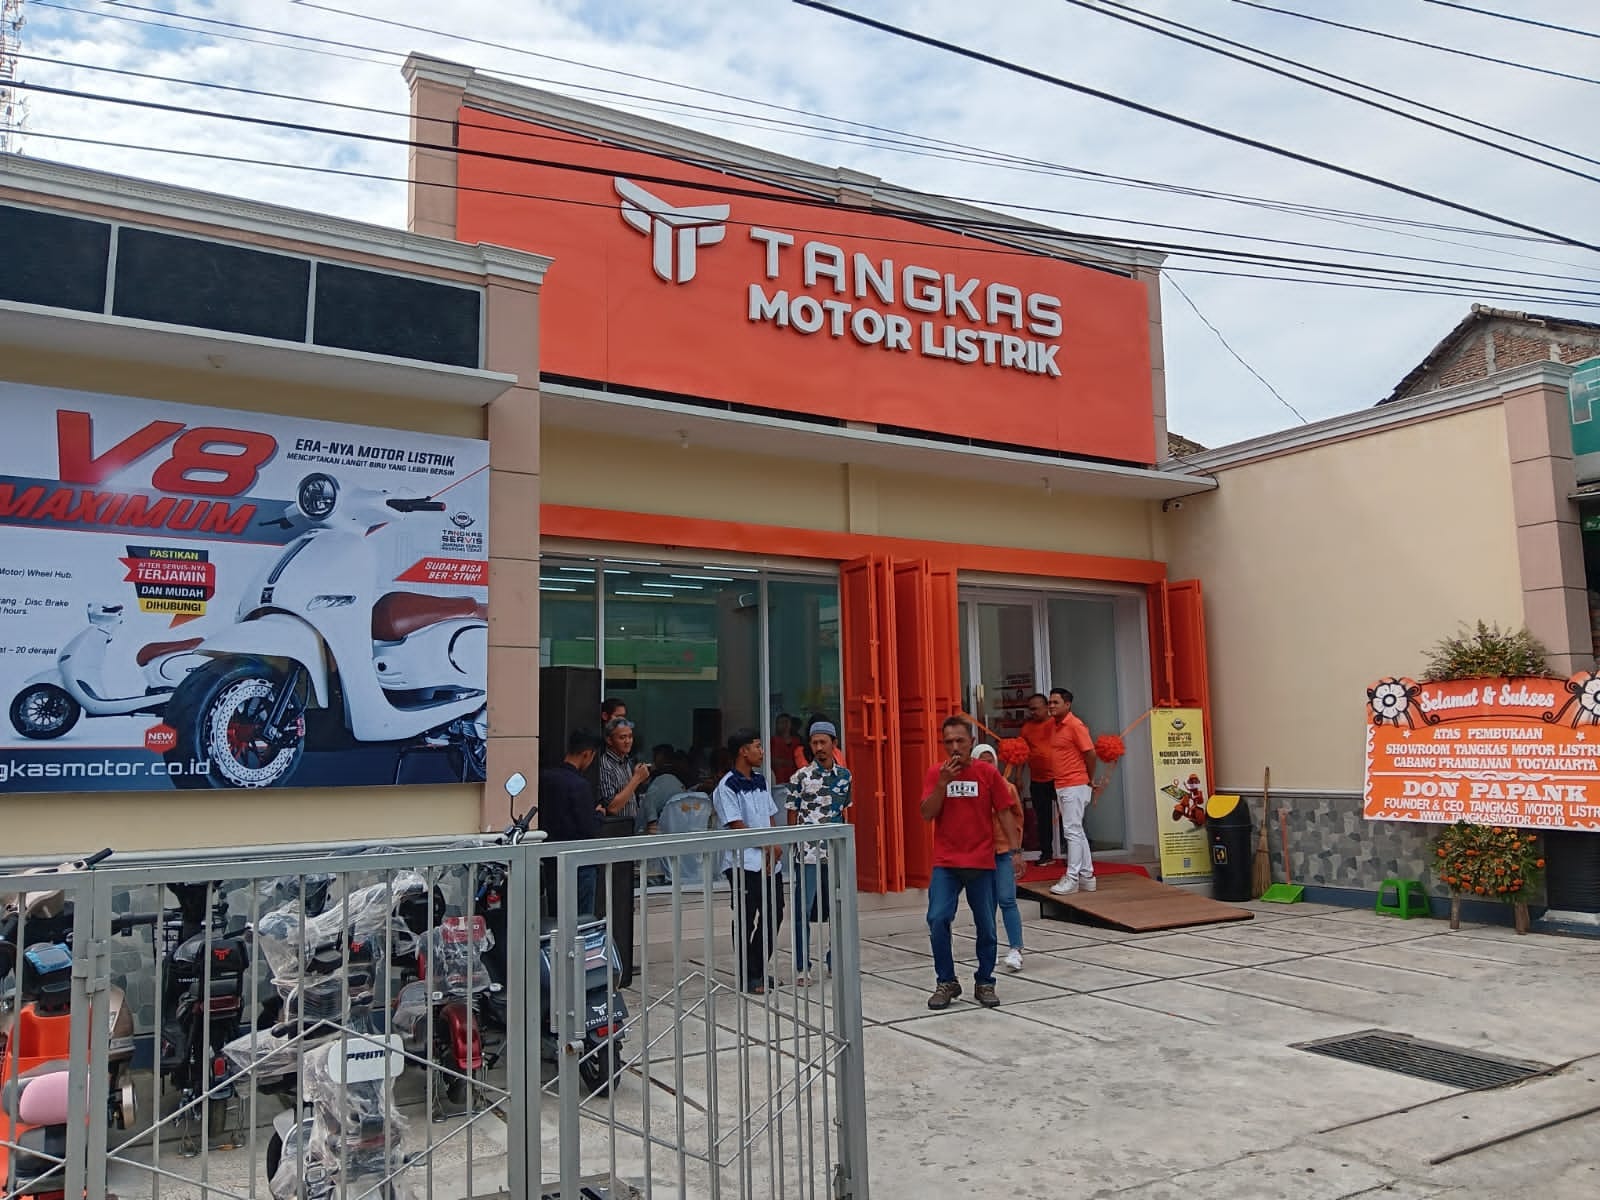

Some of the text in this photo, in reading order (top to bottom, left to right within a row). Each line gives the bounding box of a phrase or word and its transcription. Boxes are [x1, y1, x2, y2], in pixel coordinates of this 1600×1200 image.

[750, 226, 1064, 338] TANGKAS
[748, 284, 1063, 378] MOTOR LISTRIK
[56, 408, 280, 498] V8
[295, 438, 455, 468] ERA-NYA MOTOR LISTRIK
[286, 452, 455, 477] MENCIPTAKAN LANGIT BIRU YANG LEBIH BERSIH
[0, 482, 257, 535] MAXIMUM
[441, 536, 483, 545] SERVIS
[149, 549, 199, 560] PASTIKAN
[27, 568, 53, 578] Wheel
[424, 561, 482, 573] SUDAH BISA
[136, 568, 206, 582] TERJAMIN
[428, 571, 482, 582] BER-STNK!
[141, 586, 204, 598] DAN MUDAH
[24, 597, 43, 607] Disc
[44, 598, 70, 607] Brake
[146, 600, 201, 612] DIHUBUNGI
[15, 645, 27, 654] 20
[27, 646, 57, 656] derajat
[1419, 684, 1556, 713] Selamat & Sukses
[148, 732, 174, 741] NEW
[1433, 728, 1544, 741] ATAS PEMBUKAAN
[1385, 744, 1451, 757] SHOWROOM
[1453, 744, 1508, 757] TANGKAS
[1511, 744, 1556, 757] MOTOR
[1393, 757, 1598, 771] CABANG PRAMBANAN YOGYAKARTA
[0, 759, 211, 783] gkasmotor.co.id
[1403, 780, 1588, 803] DON PAPANK
[1384, 798, 1430, 810] FOUNDER
[1432, 800, 1440, 811] &
[1443, 800, 1465, 812] CEO
[1469, 801, 1519, 814] TANGKAS
[1525, 803, 1564, 817] MOTOR
